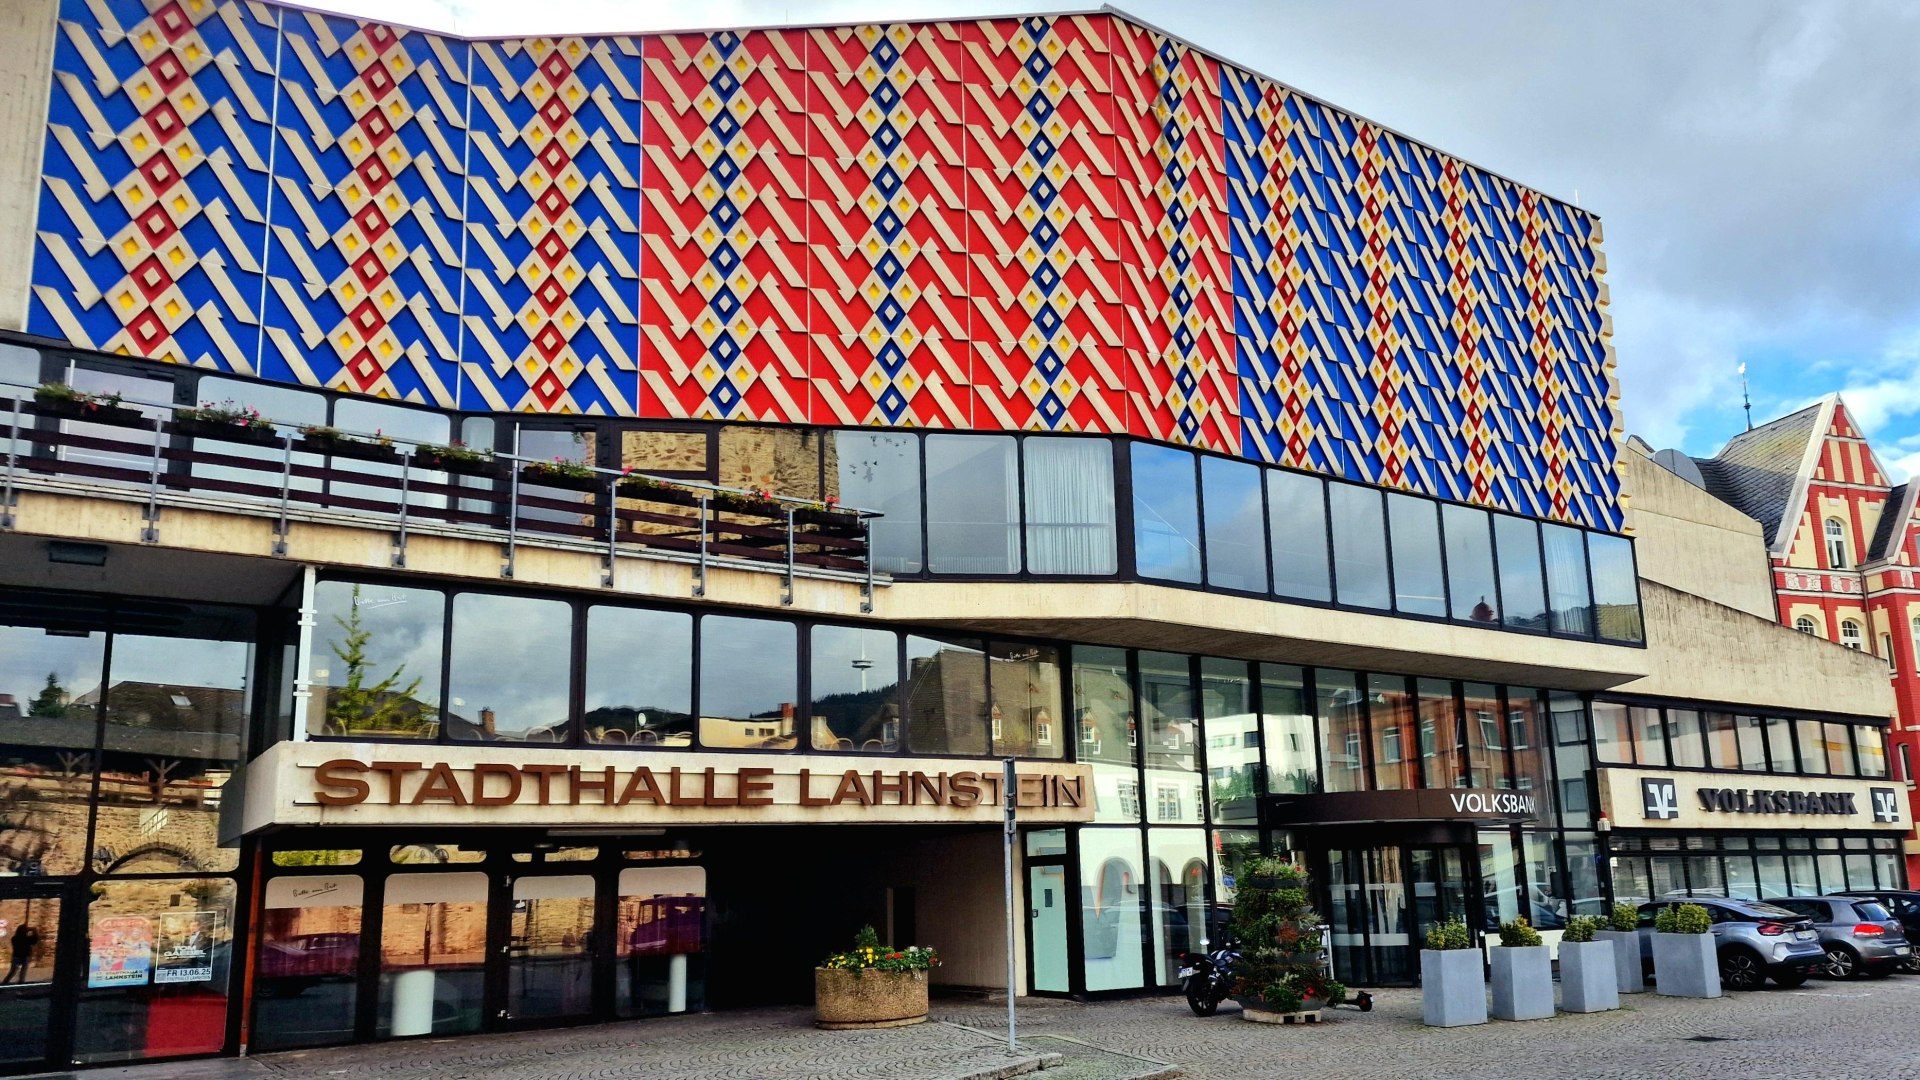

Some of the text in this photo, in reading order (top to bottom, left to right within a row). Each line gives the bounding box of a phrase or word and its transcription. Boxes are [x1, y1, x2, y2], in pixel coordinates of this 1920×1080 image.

[314, 759, 1086, 808] STADTHALLE LAHNSTEIN
[1450, 793, 1536, 814] VOLKSBANK
[1697, 787, 1858, 815] VOLKSBANK
[167, 969, 178, 977] FR
[180, 968, 211, 976] 13.06.25
